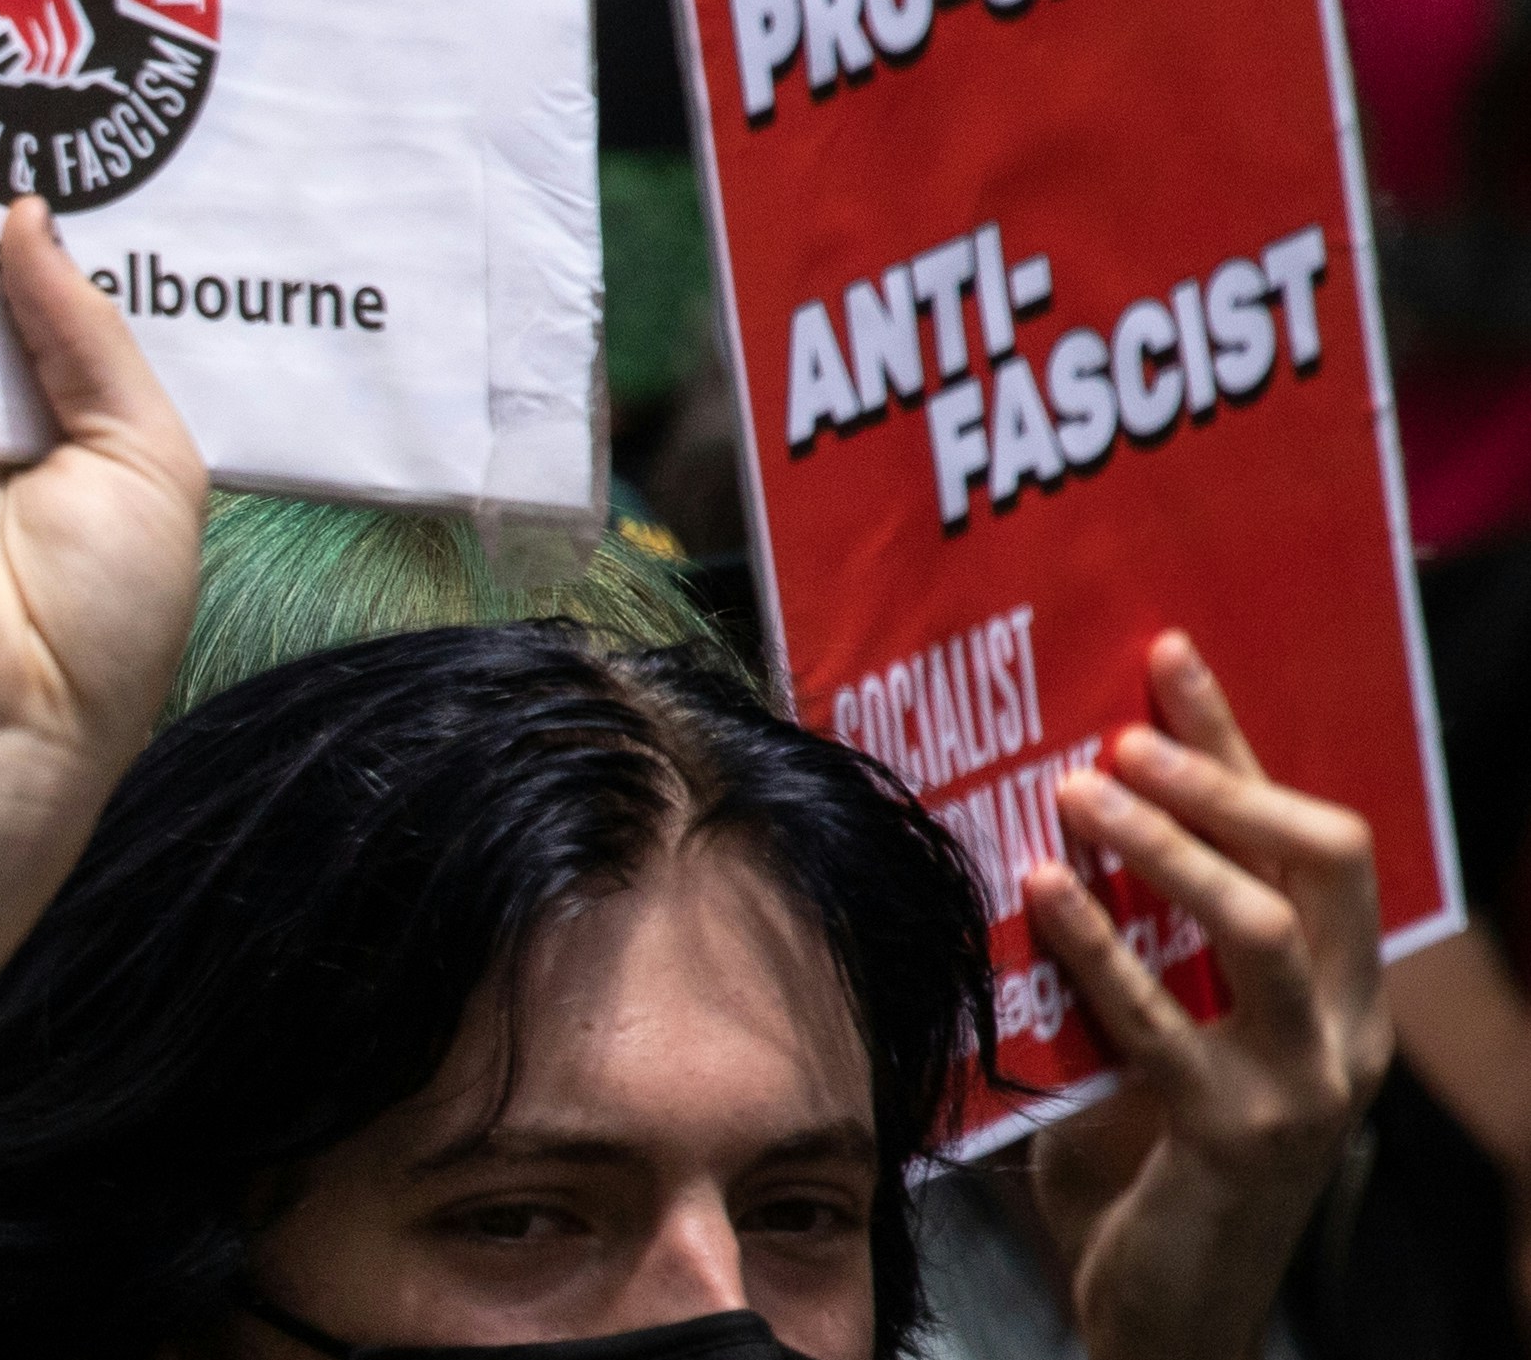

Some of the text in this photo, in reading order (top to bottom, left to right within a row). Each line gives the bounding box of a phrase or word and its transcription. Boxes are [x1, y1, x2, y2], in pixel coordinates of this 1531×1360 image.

[12, 133, 39, 192] &
[54, 37, 203, 196] FASCISM
[788, 223, 1053, 454] ANTI-
[925, 224, 1327, 536] FASCIST
